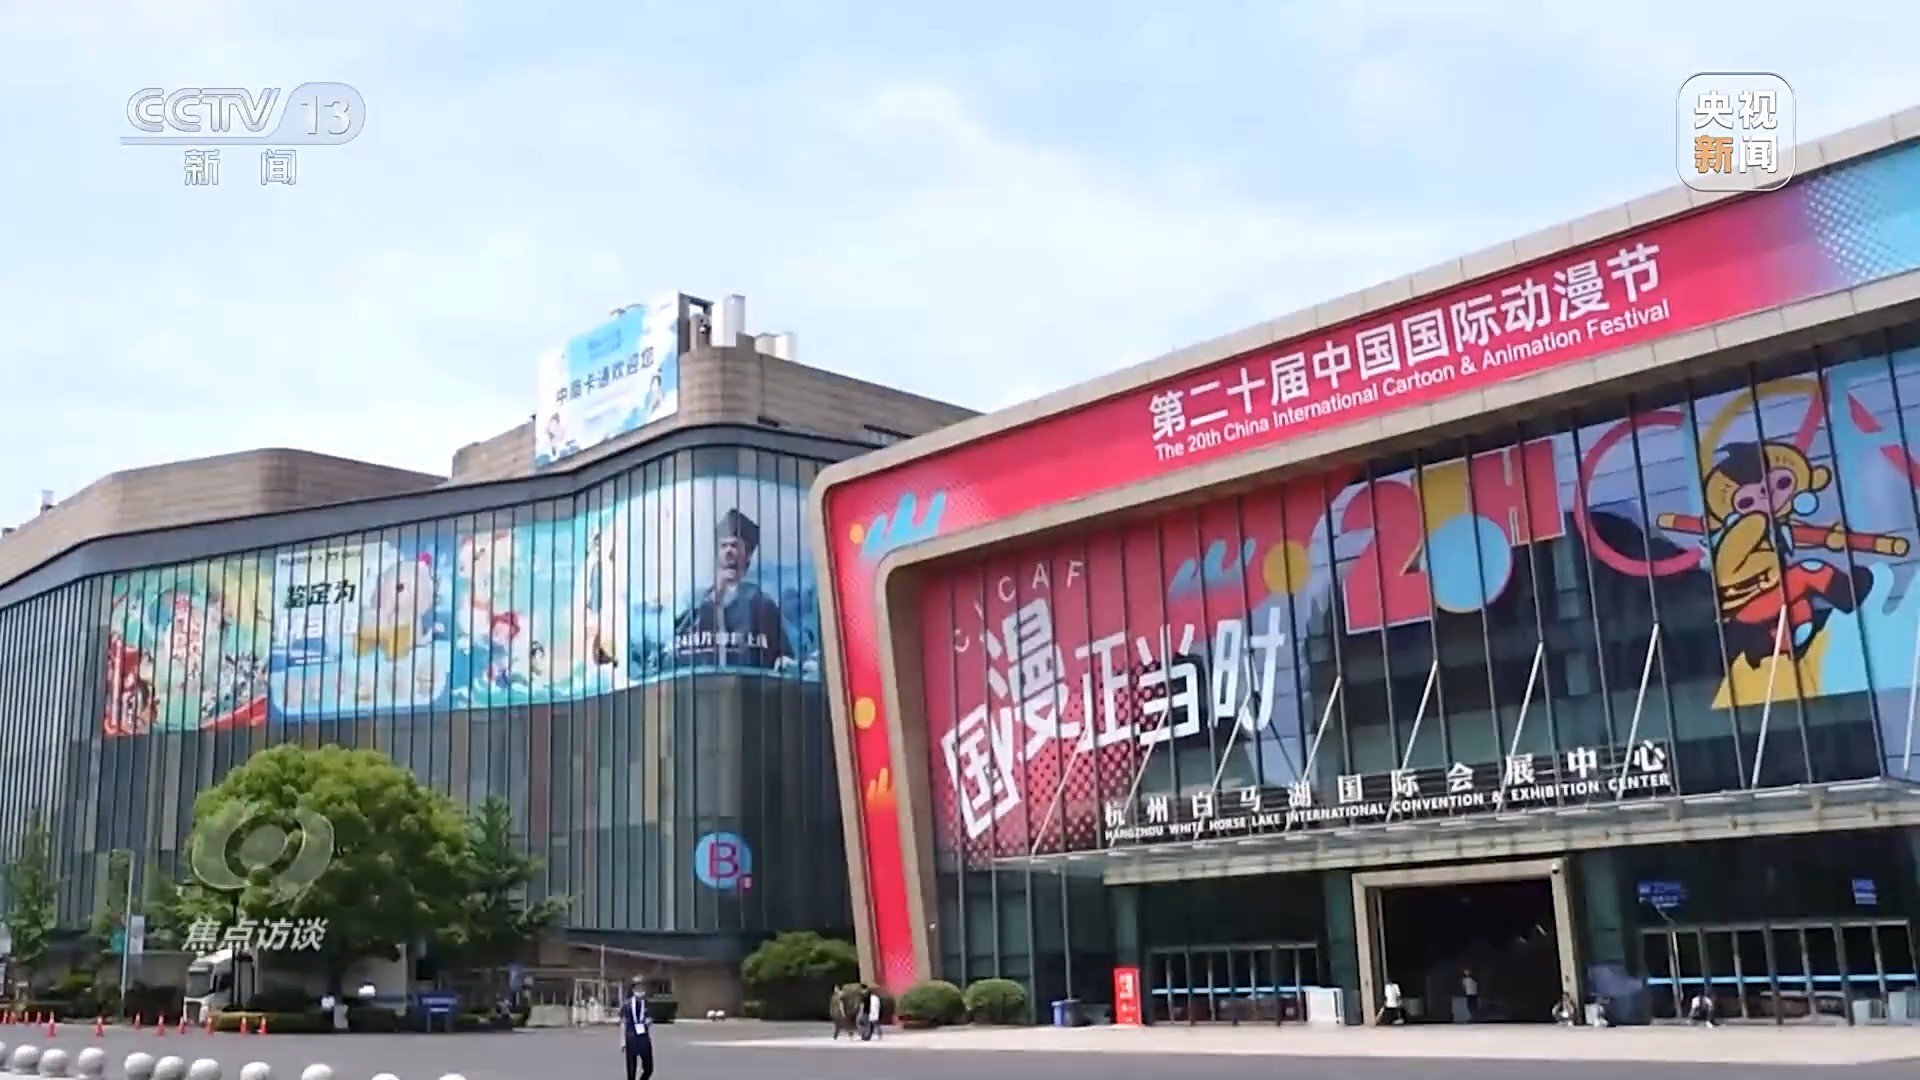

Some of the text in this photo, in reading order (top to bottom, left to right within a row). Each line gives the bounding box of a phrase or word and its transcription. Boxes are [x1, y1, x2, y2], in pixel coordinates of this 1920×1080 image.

[1149, 243, 1660, 441] 第二十届中国国际动漫节
[1156, 299, 1670, 462] The 20th China International Cartoon & Animation Festival
[941, 598, 1286, 840] 国漫正当时
[1105, 740, 1666, 828] 杭州白马湖国际会展中心
[1105, 825, 1164, 841] HANGZHOU
[1168, 821, 1205, 835] WHITE
[1209, 817, 1246, 831] HORSE
[1252, 813, 1281, 827] LAKE
[1286, 803, 1386, 823] INTERNATIONAL
[1393, 793, 1485, 813] CONVENTION
[1511, 780, 1600, 802] EXHIBITION
[1608, 772, 1672, 792] CENTER
[709, 842, 739, 879] B
